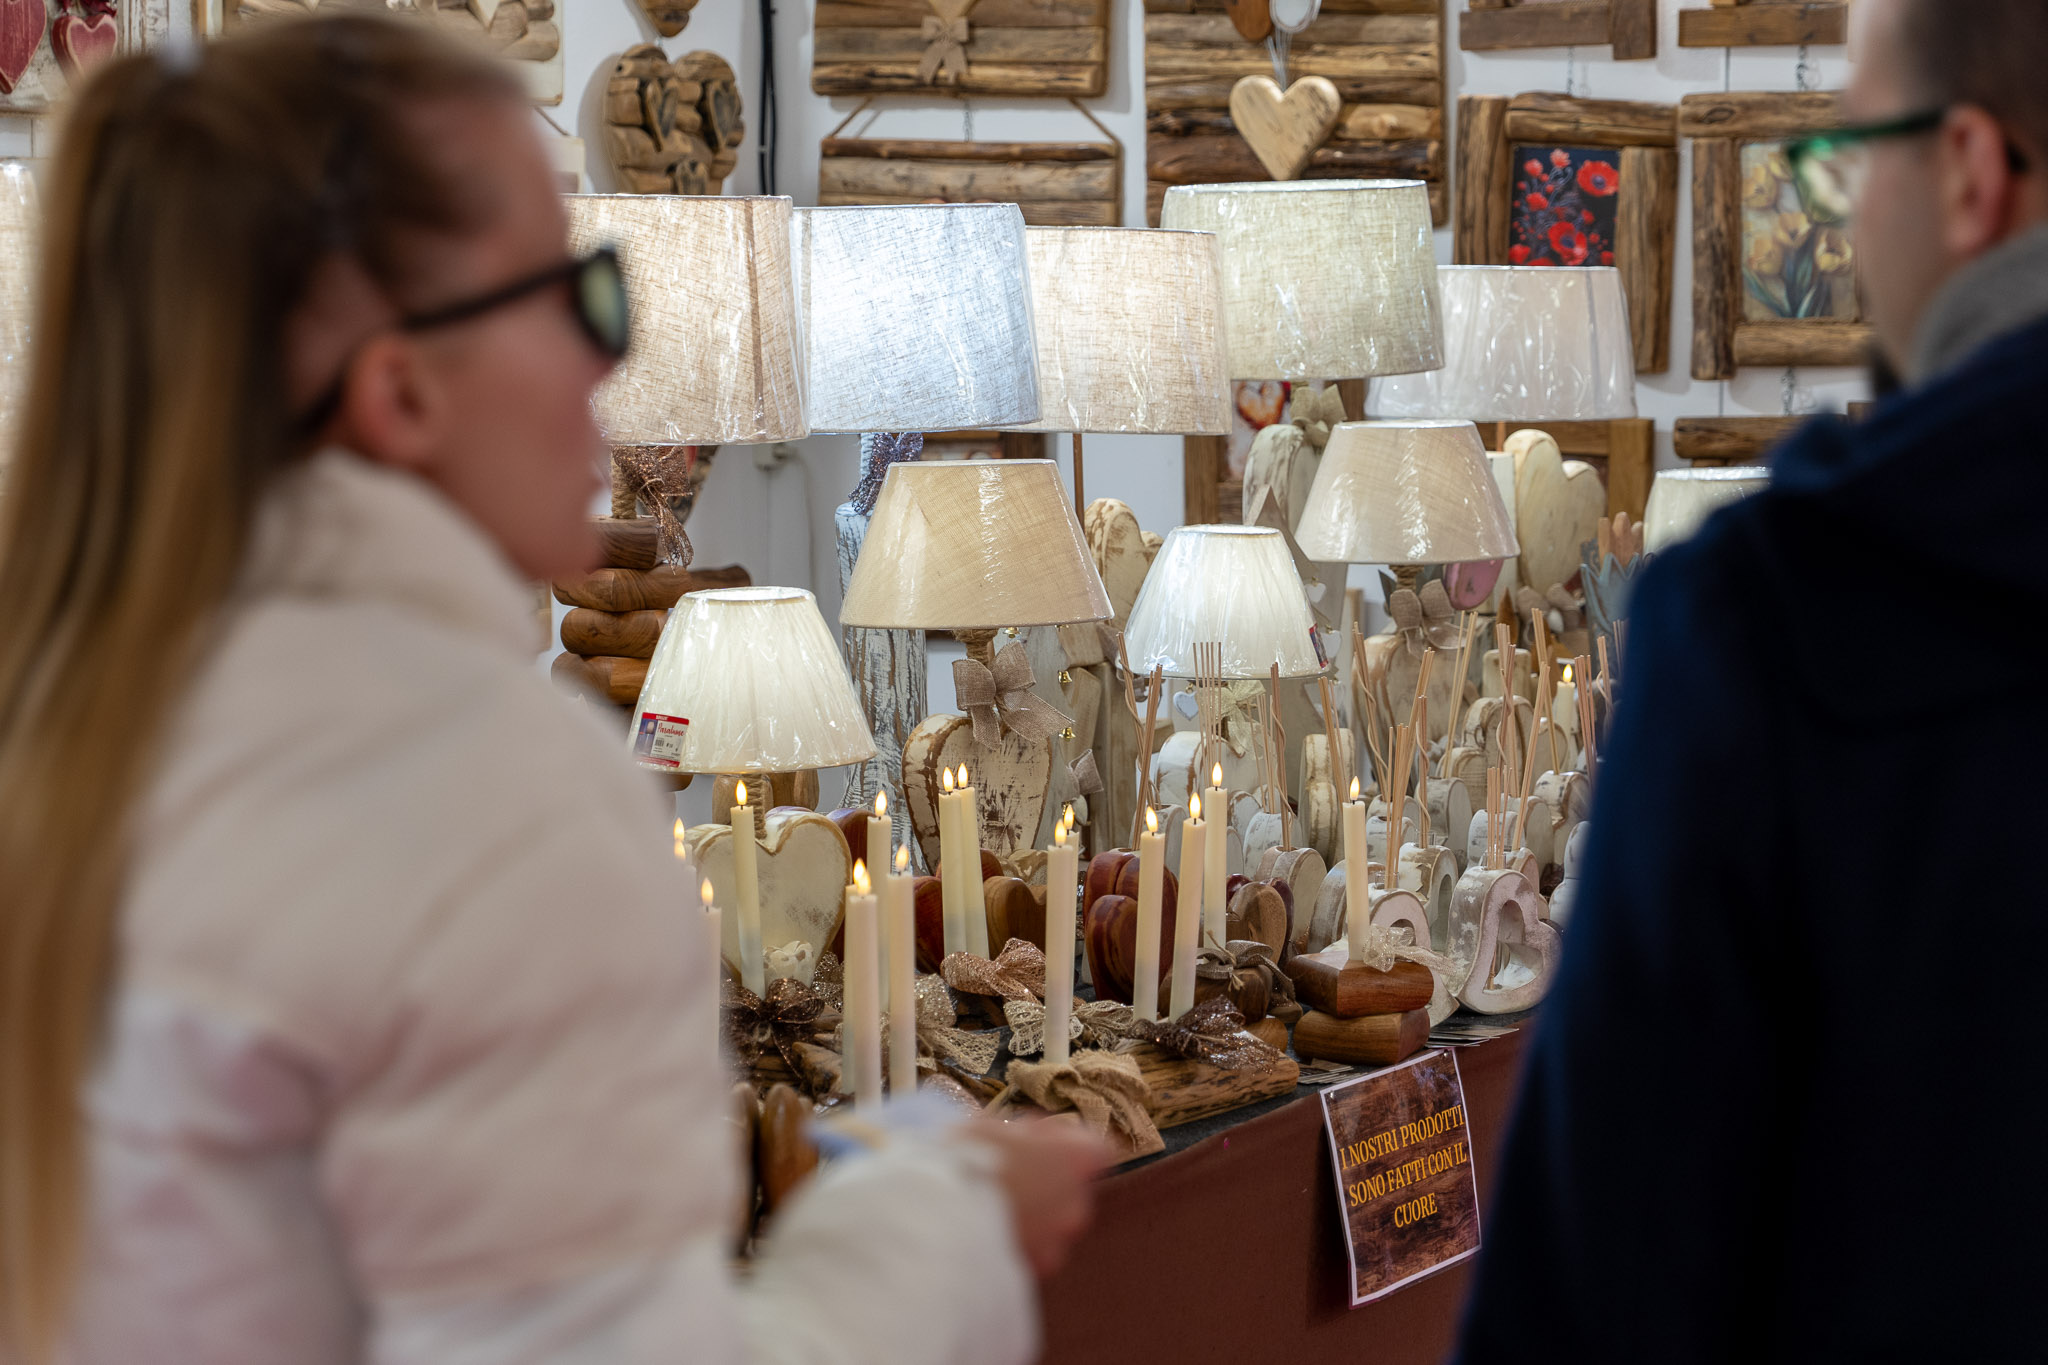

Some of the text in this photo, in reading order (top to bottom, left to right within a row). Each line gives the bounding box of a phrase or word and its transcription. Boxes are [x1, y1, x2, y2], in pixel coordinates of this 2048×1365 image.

[1340, 1105, 1464, 1170] I NOSTRI PRODOTTI
[1349, 1142, 1467, 1207] SONO FATTI CON IL
[1394, 1193, 1438, 1228] CUORE
